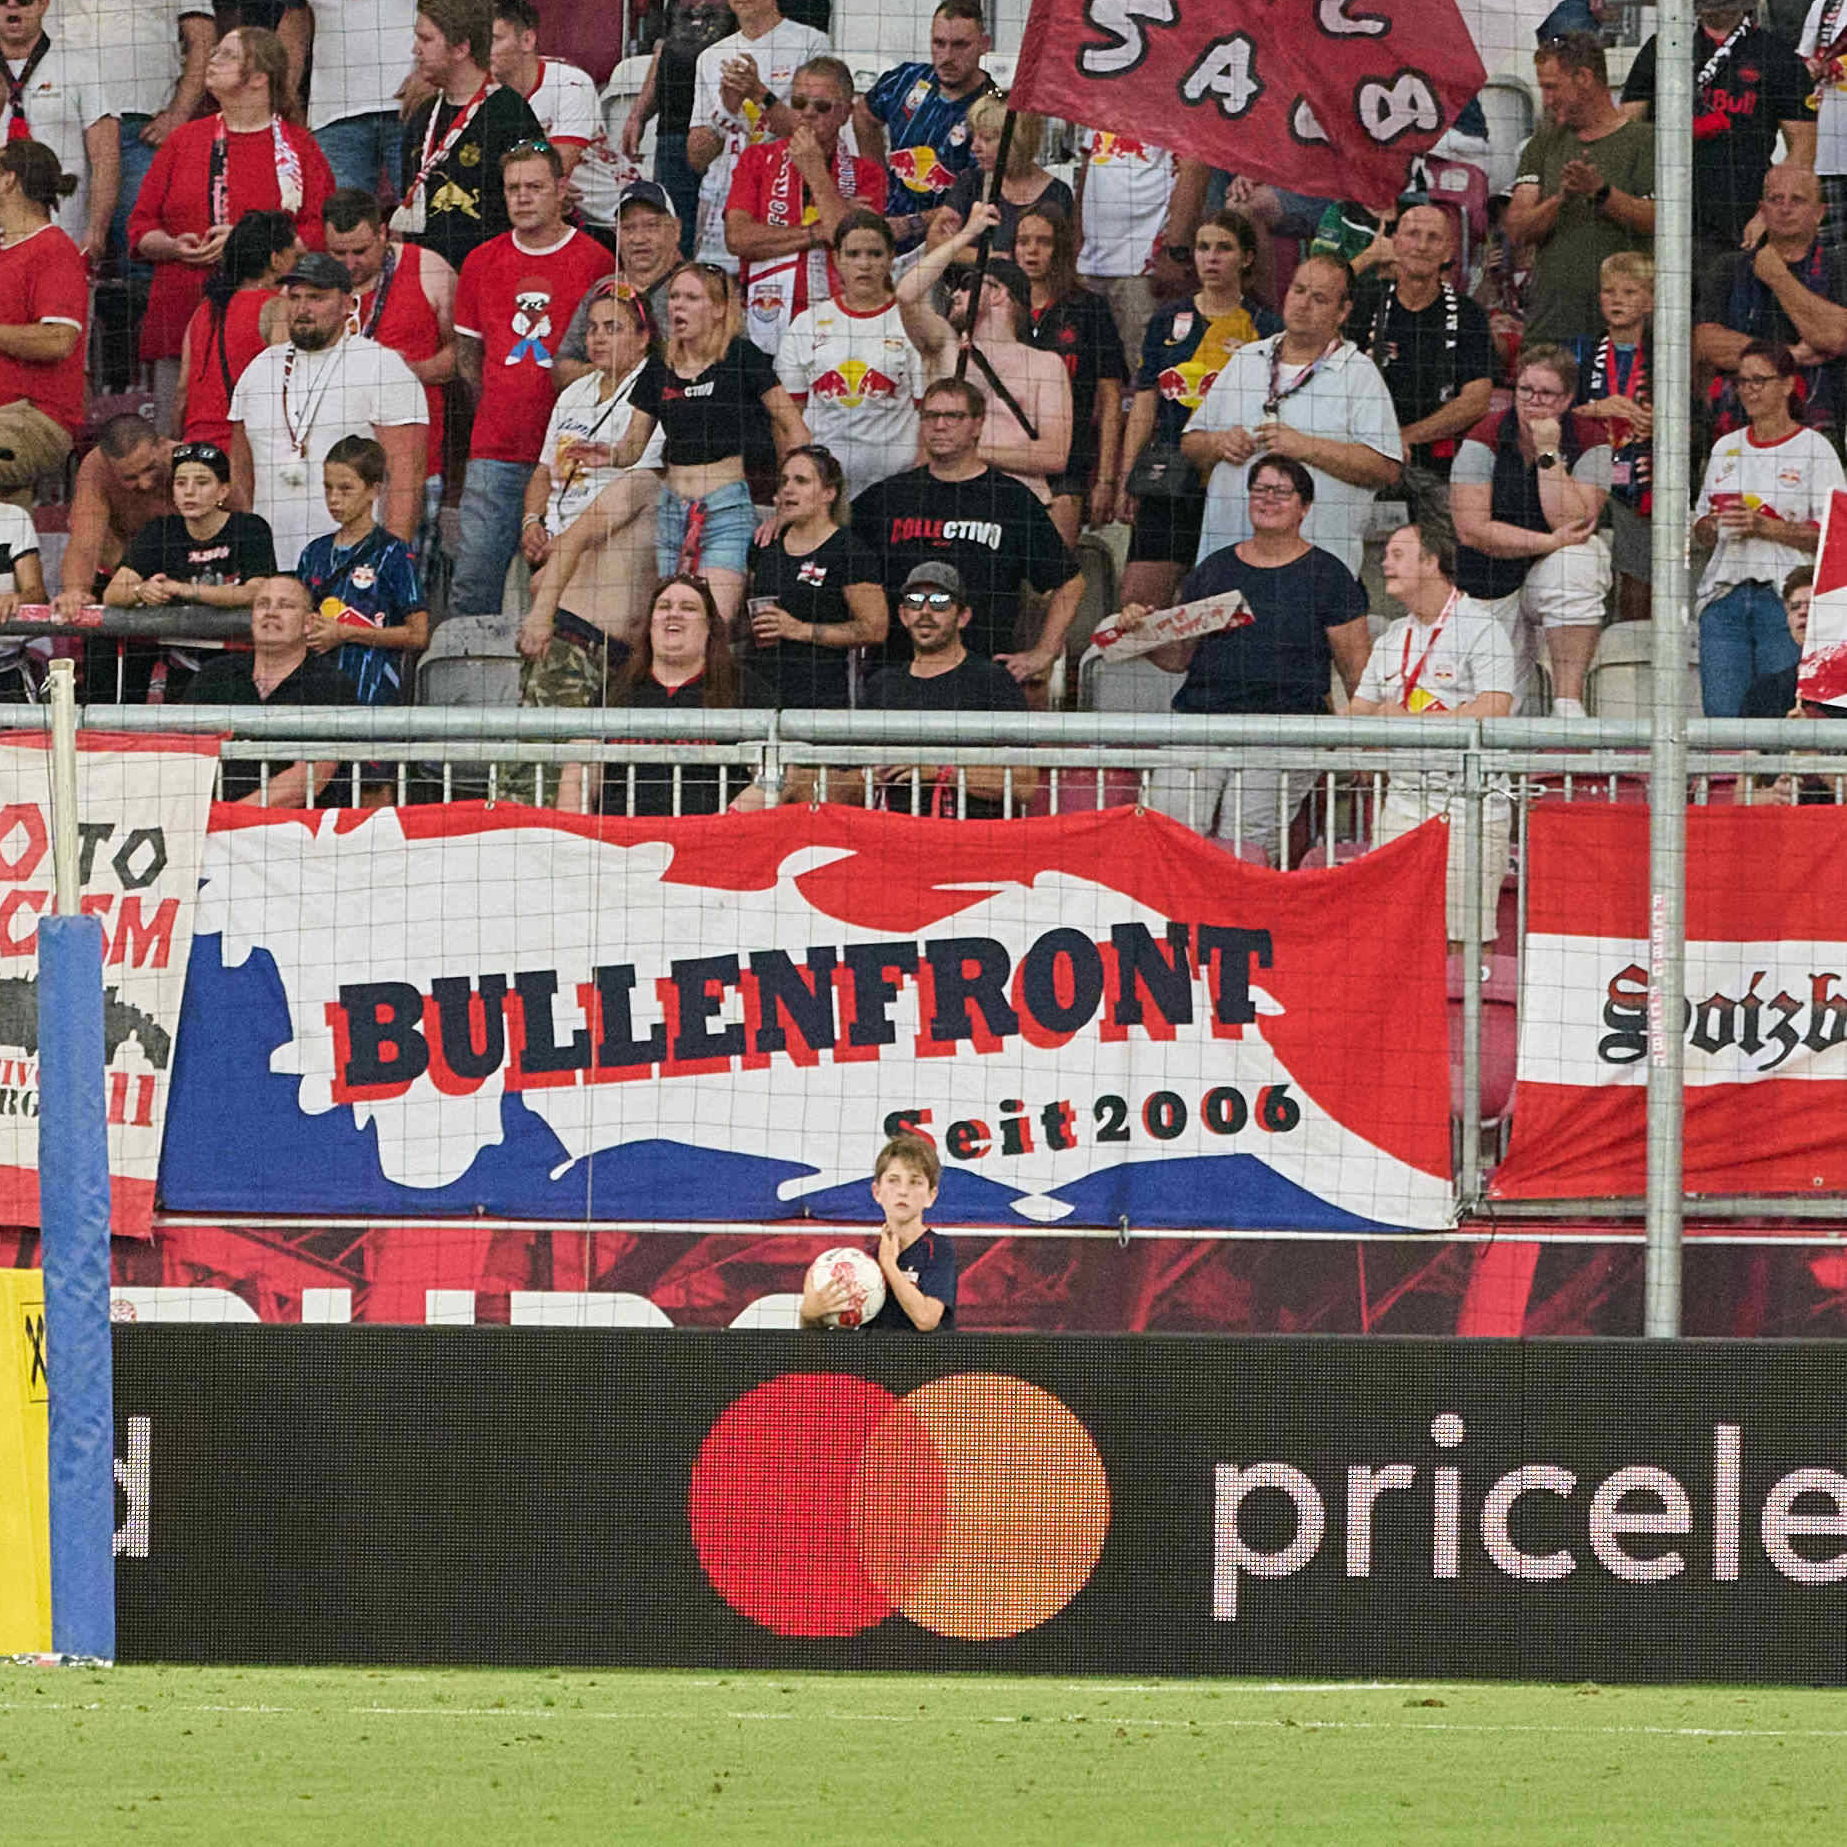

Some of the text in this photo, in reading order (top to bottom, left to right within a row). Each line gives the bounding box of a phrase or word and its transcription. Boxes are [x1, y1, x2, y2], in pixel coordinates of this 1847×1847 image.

[890, 518, 1003, 551] COLLECTIVO
[75, 821, 169, 892] TO
[328, 920, 1274, 1104] BULLENFRONT
[883, 1082, 1301, 1162] Seit 2006
